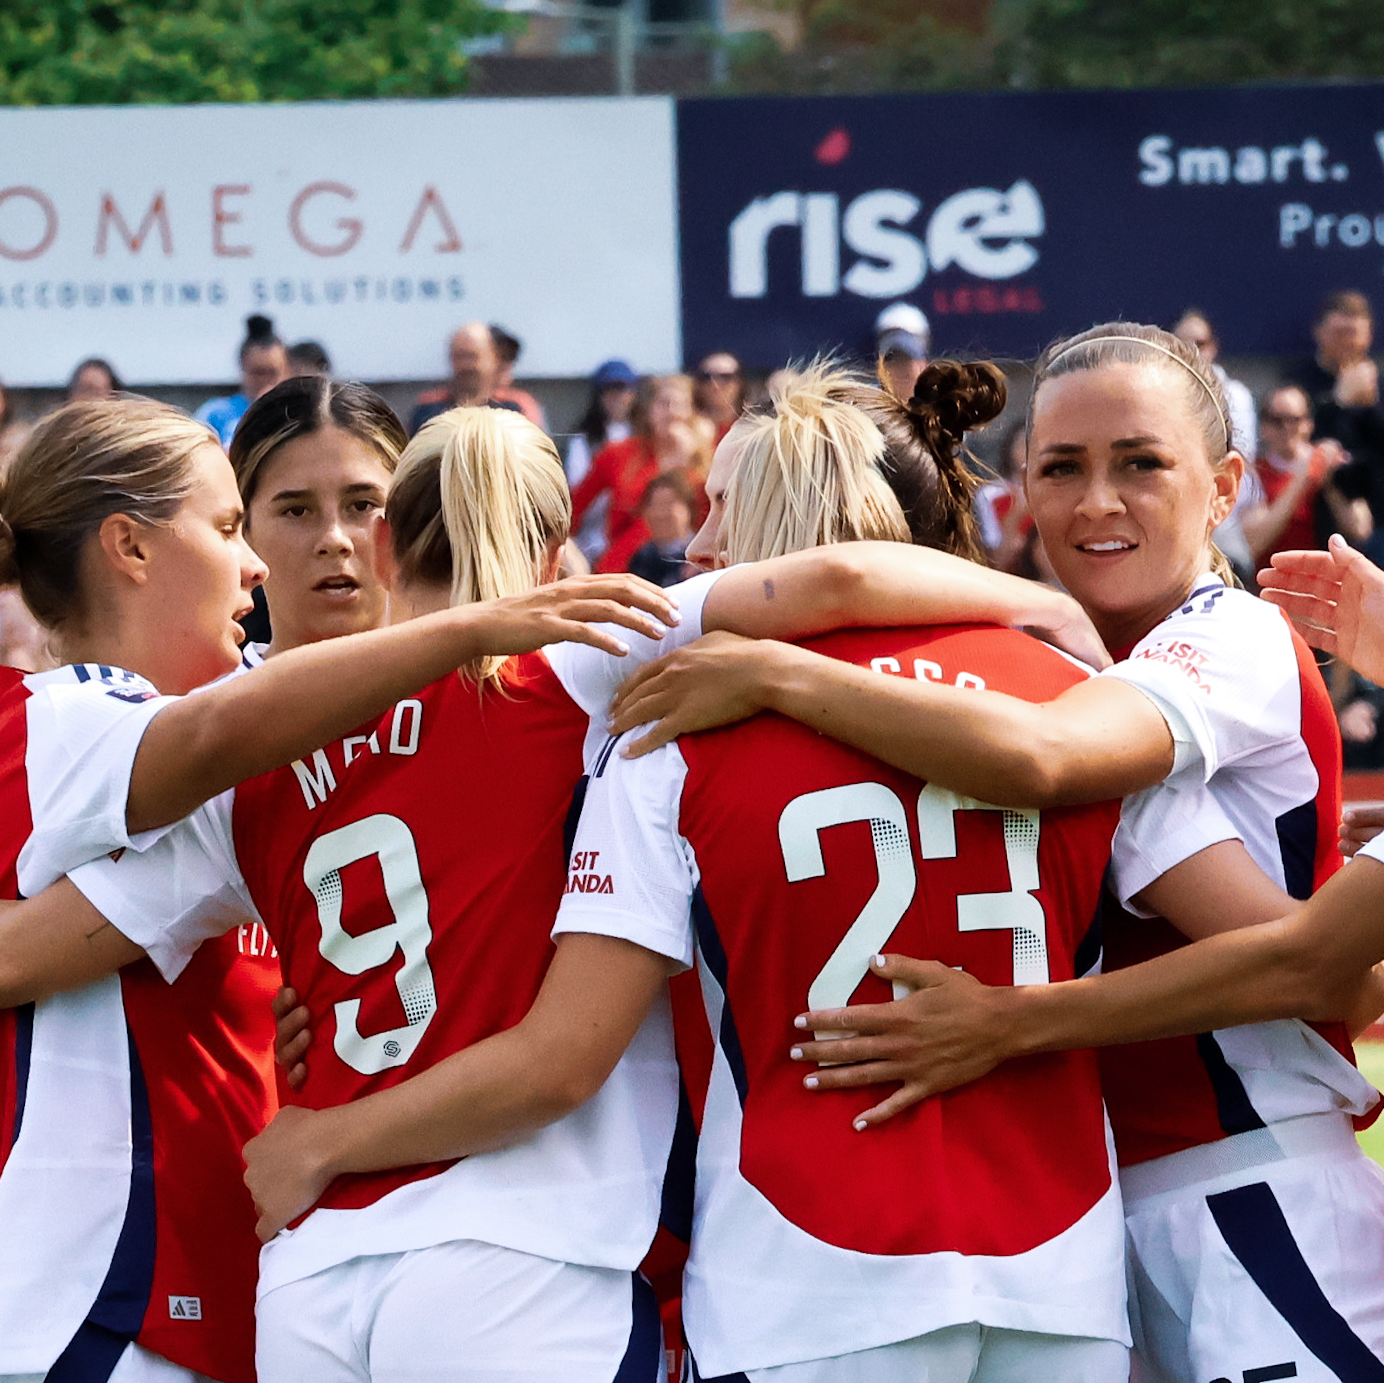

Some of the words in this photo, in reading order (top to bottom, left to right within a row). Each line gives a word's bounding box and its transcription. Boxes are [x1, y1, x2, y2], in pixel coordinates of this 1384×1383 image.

[1139, 136, 1349, 186] Smart.
[250, 275, 468, 304] SOLUTIONS
[304, 813, 438, 1076] 9
